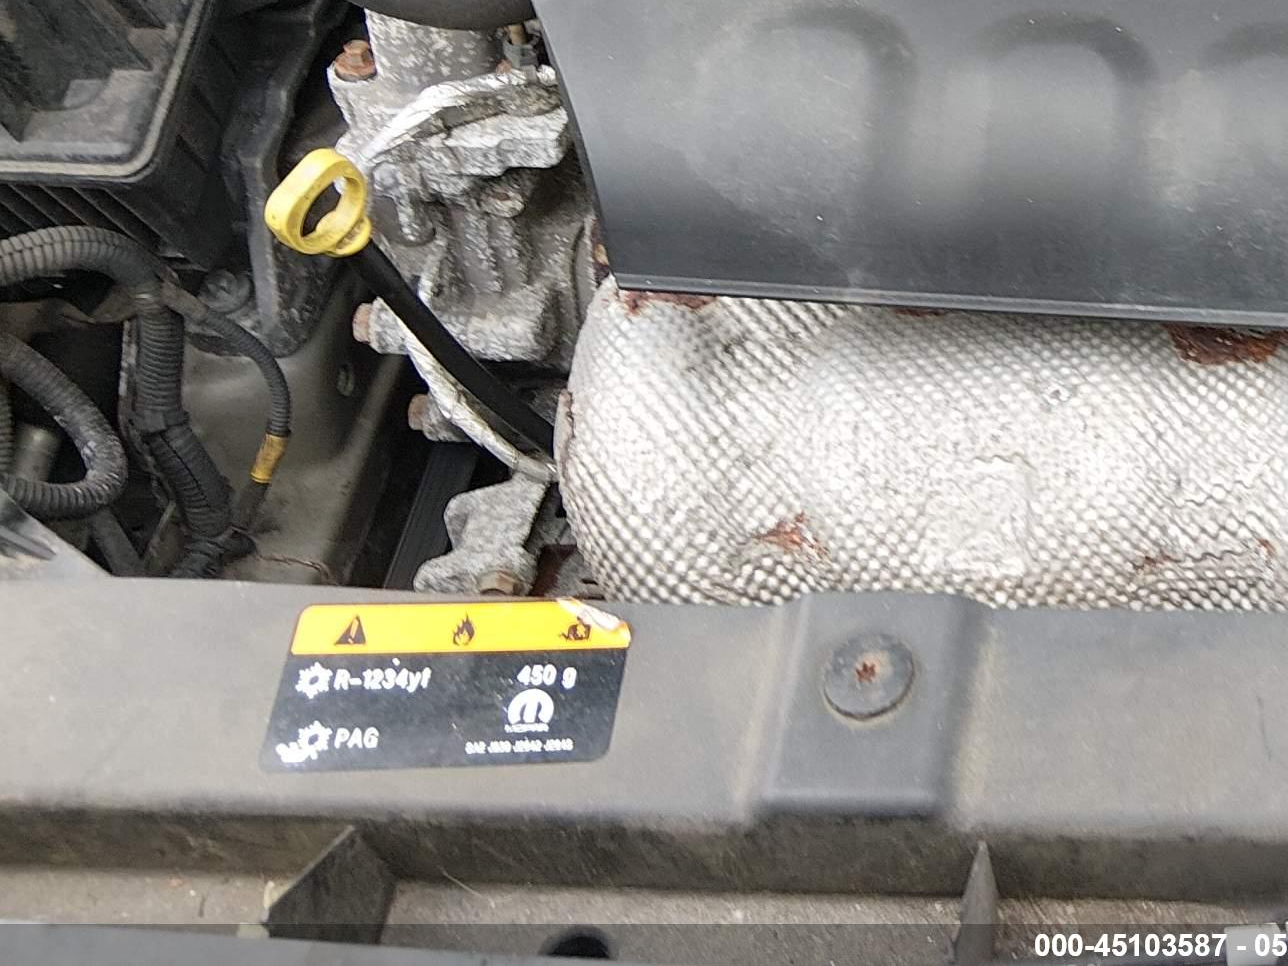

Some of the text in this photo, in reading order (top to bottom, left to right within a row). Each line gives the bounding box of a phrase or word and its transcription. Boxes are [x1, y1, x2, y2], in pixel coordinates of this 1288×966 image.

[334, 664, 577, 693] R-1234yf 450 g
[334, 727, 380, 749] PAG
